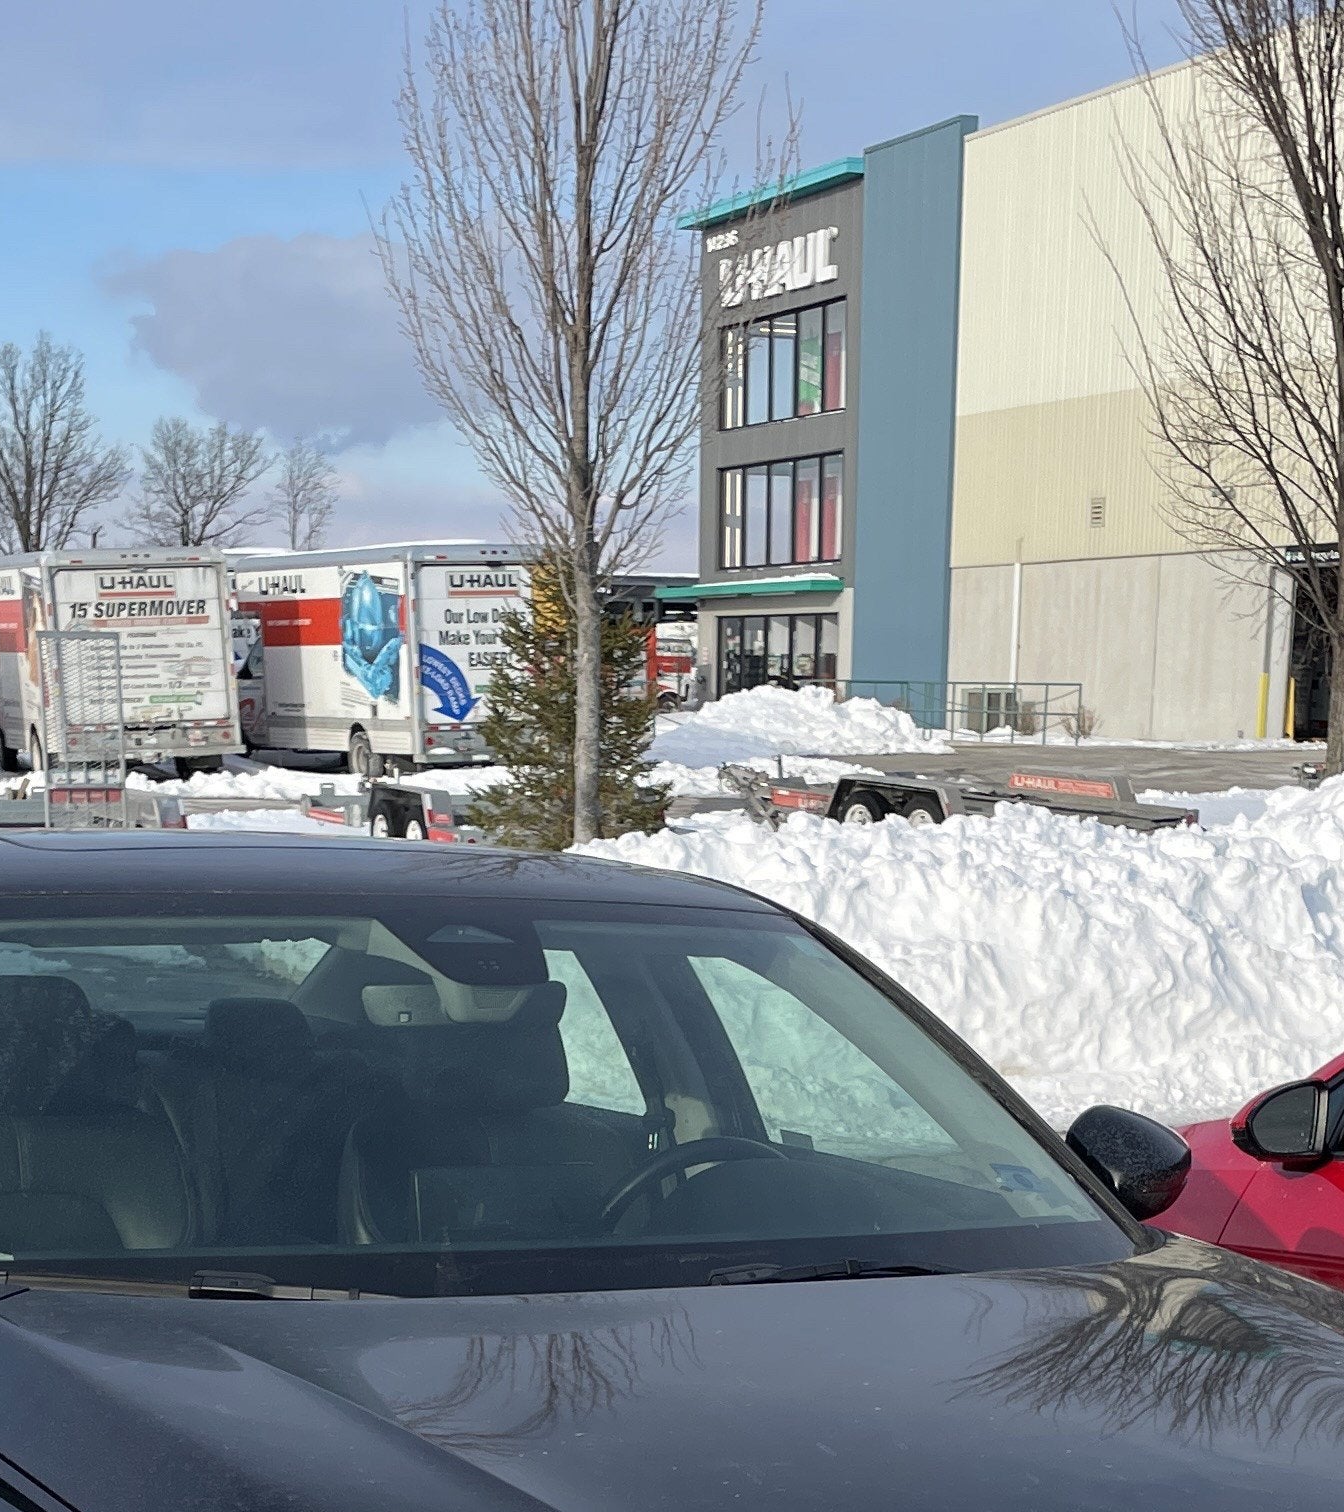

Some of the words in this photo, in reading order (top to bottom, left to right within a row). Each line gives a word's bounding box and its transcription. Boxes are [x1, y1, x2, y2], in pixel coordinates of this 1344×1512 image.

[100, 575, 174, 590] U-HAUL
[449, 574, 517, 588] U-HAUL
[94, 599, 206, 619] SUPERMOVER
[444, 608, 464, 624] Our
[466, 608, 489, 624] Low
[438, 630, 471, 646] Make
[472, 629, 498, 645] Your
[1012, 775, 1058, 790] U-HAUL
